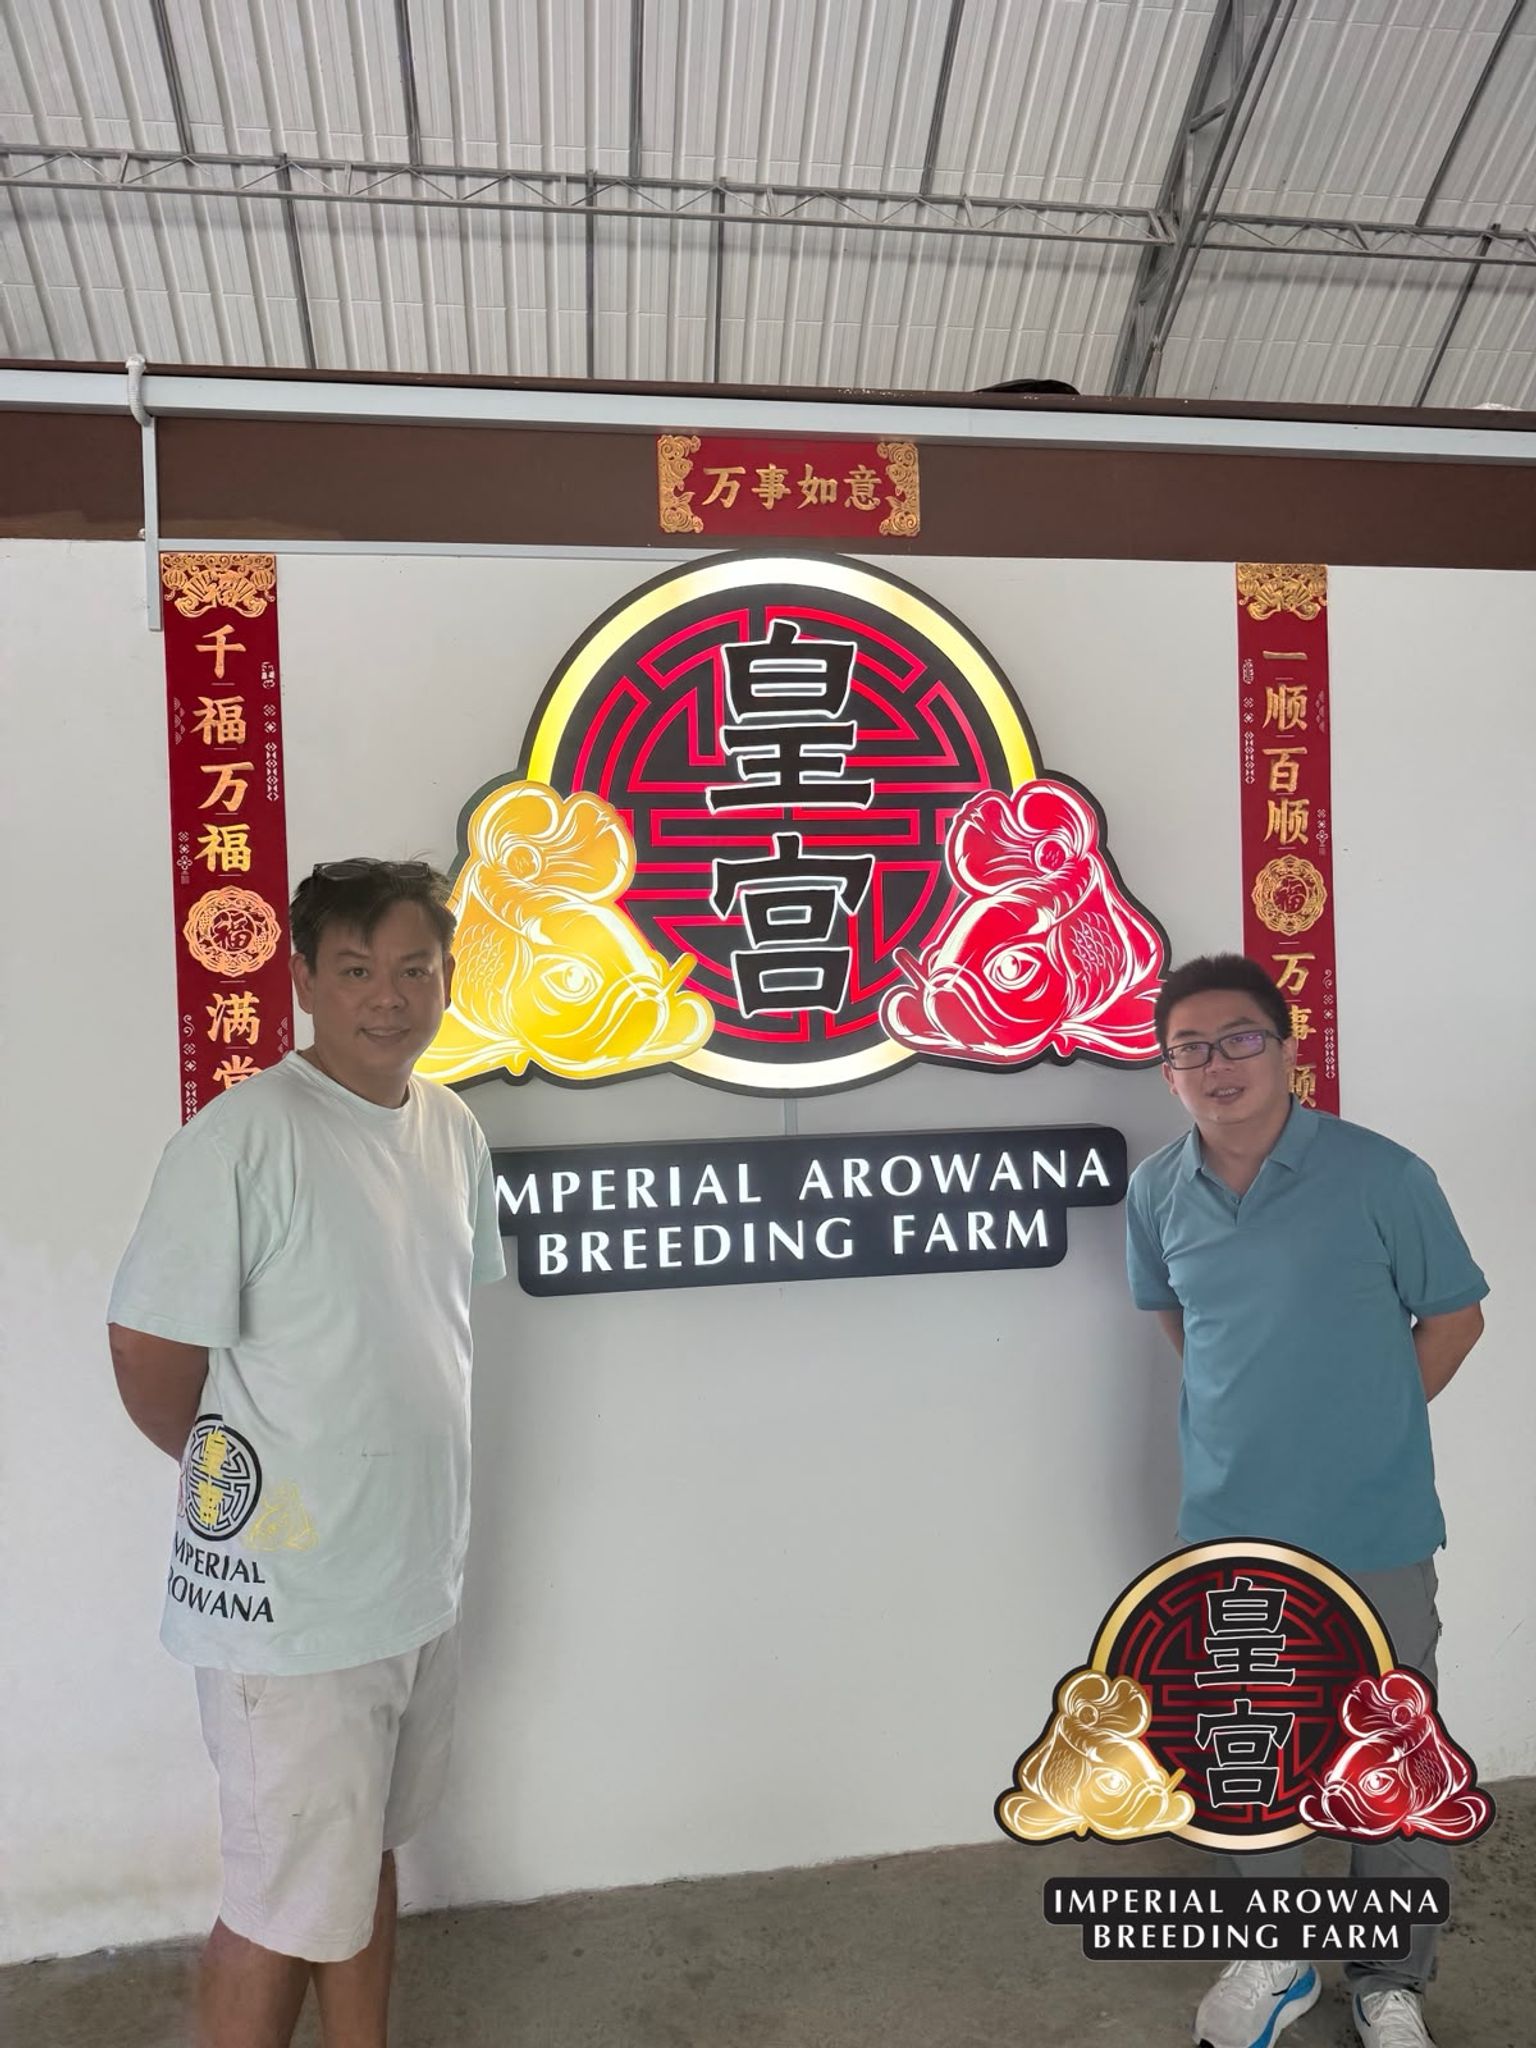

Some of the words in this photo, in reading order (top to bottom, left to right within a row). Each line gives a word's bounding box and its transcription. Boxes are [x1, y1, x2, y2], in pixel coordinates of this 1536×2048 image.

[701, 463, 882, 511] 万事如意
[190, 624, 256, 873] 千福万福
[1262, 650, 1310, 845] 一顺百顺
[213, 910, 254, 950] 福
[496, 1163, 762, 1216] MPERIAL
[798, 1148, 1111, 1200] AROWANA
[538, 1217, 853, 1276] BREEDING
[893, 1209, 1049, 1255] FARM
[175, 1531, 266, 1584] MPERIAL
[168, 1565, 275, 1623] OWANA
